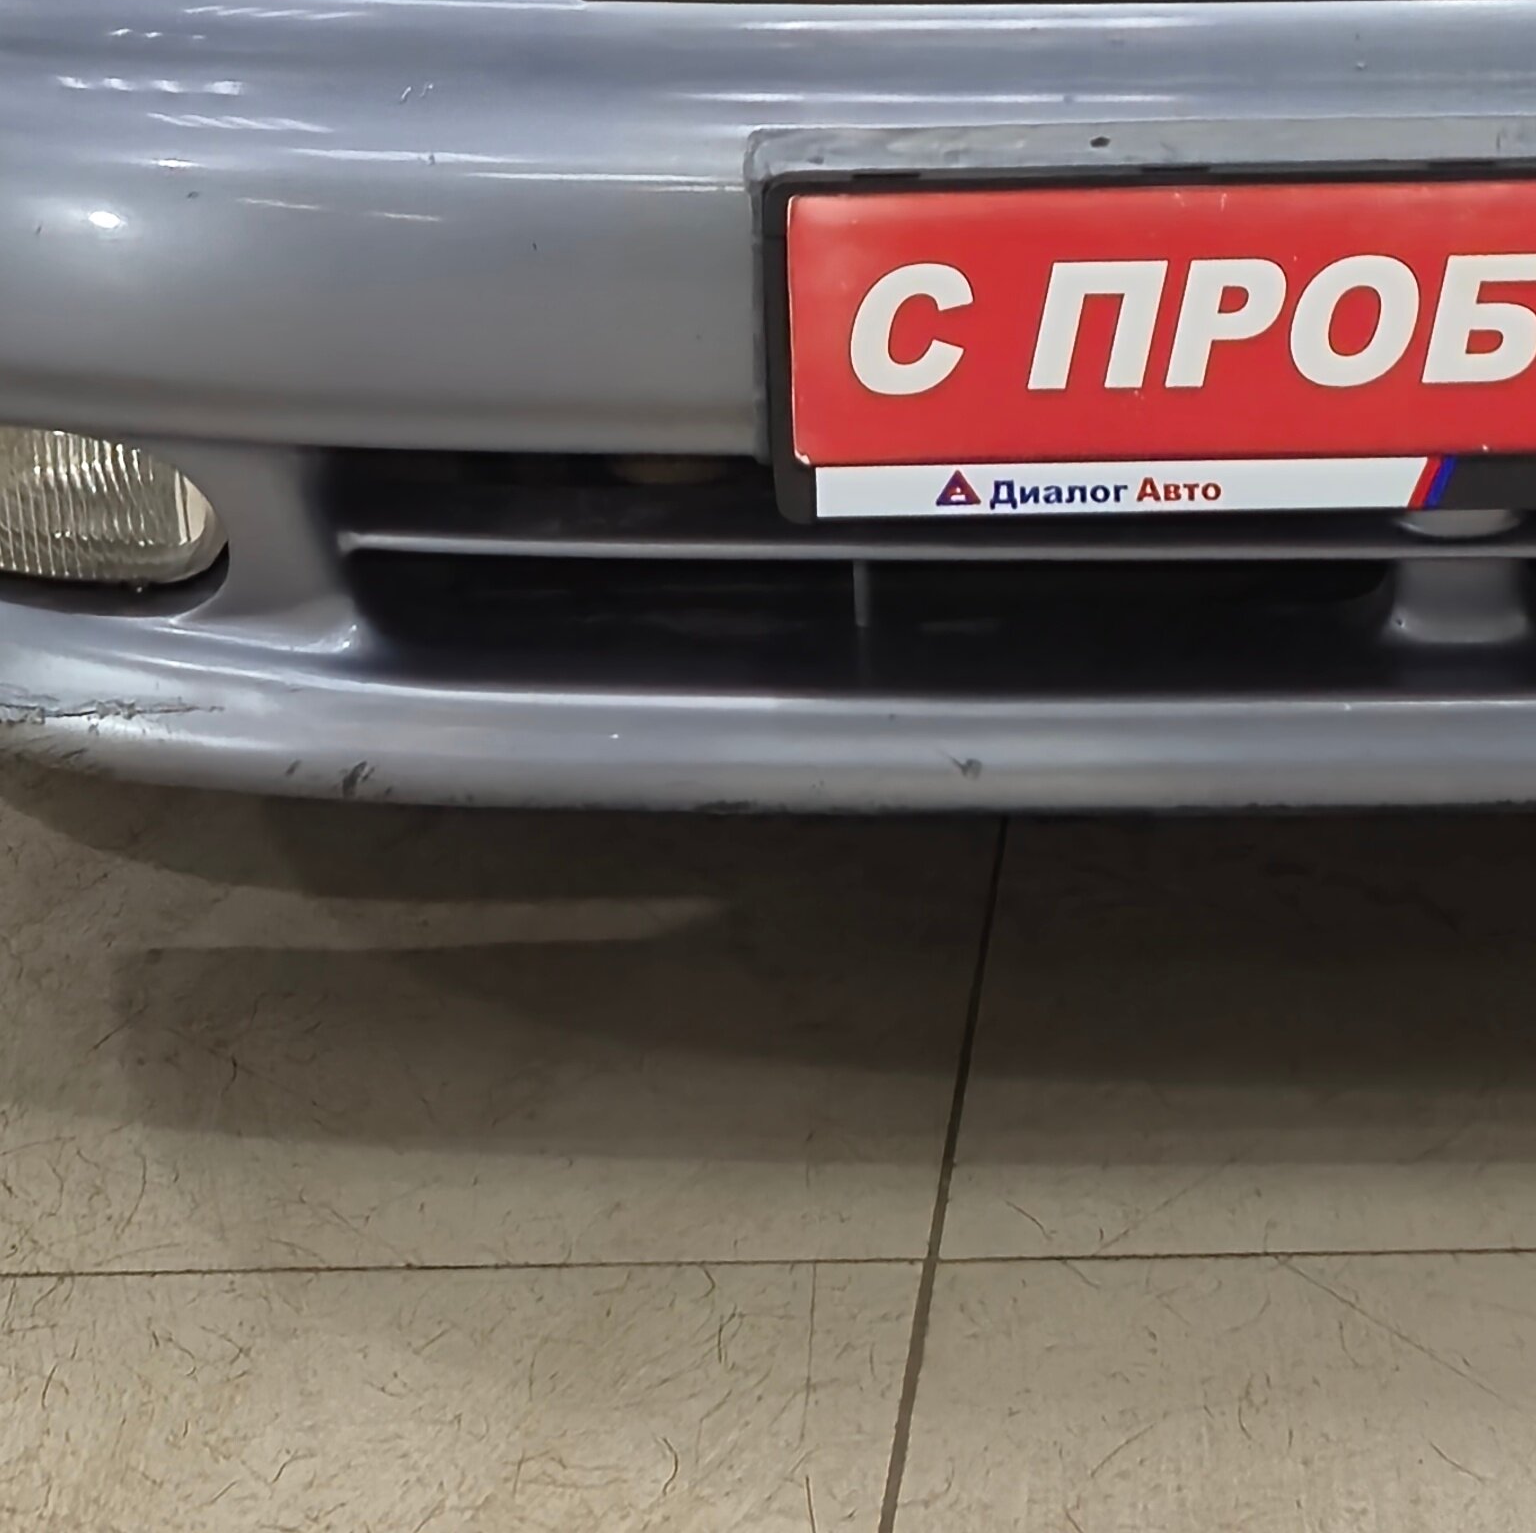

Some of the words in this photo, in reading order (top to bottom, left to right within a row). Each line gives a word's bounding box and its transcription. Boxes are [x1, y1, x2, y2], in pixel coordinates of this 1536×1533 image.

[850, 263, 974, 396] С
[989, 479, 1129, 511] Диалог
[1136, 476, 1223, 504] Авто
